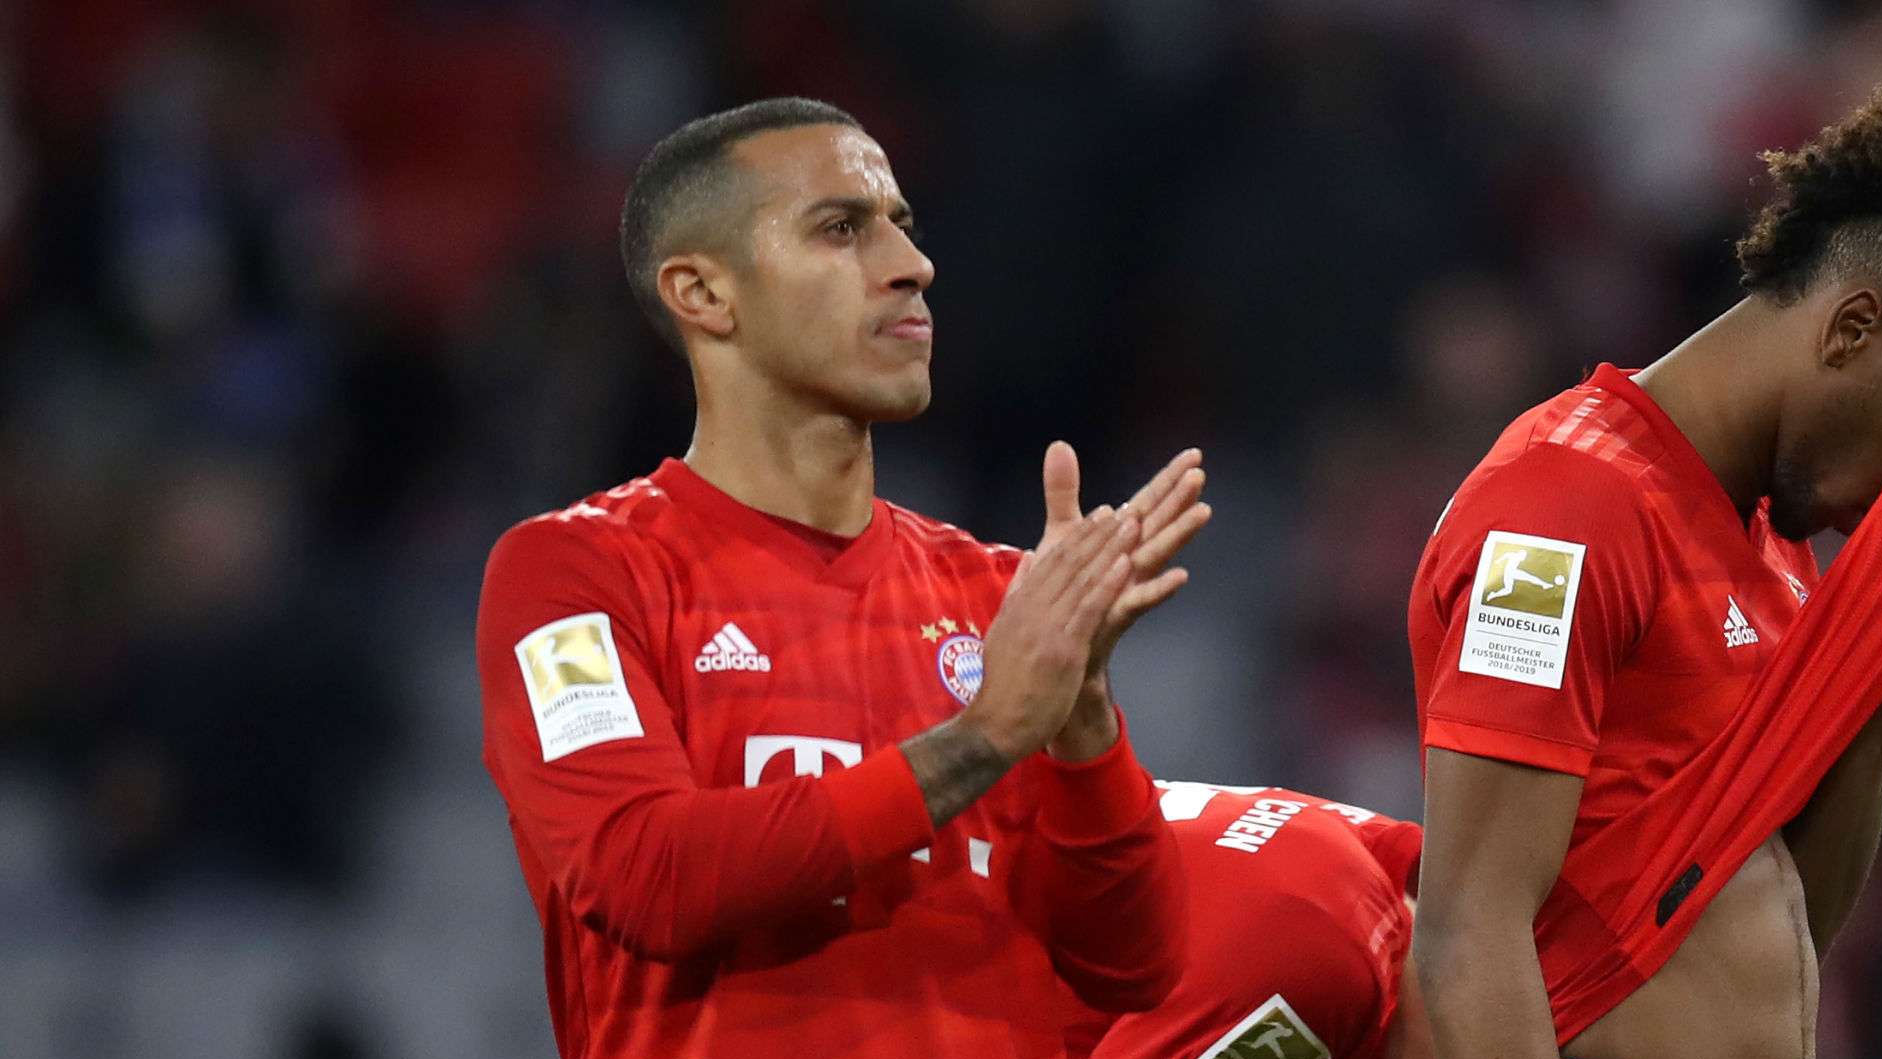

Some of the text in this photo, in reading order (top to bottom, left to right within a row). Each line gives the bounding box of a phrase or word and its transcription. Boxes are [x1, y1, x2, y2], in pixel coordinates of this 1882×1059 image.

[1478, 612, 1560, 637] BUNDESLIGA
[1472, 648, 1556, 670] FUSSBALLMEISTER
[1488, 641, 1542, 658] DEUTSCHER
[694, 651, 772, 673] adidas
[1487, 659, 1536, 676] 2018/2019
[1214, 798, 1309, 854] CHEN
